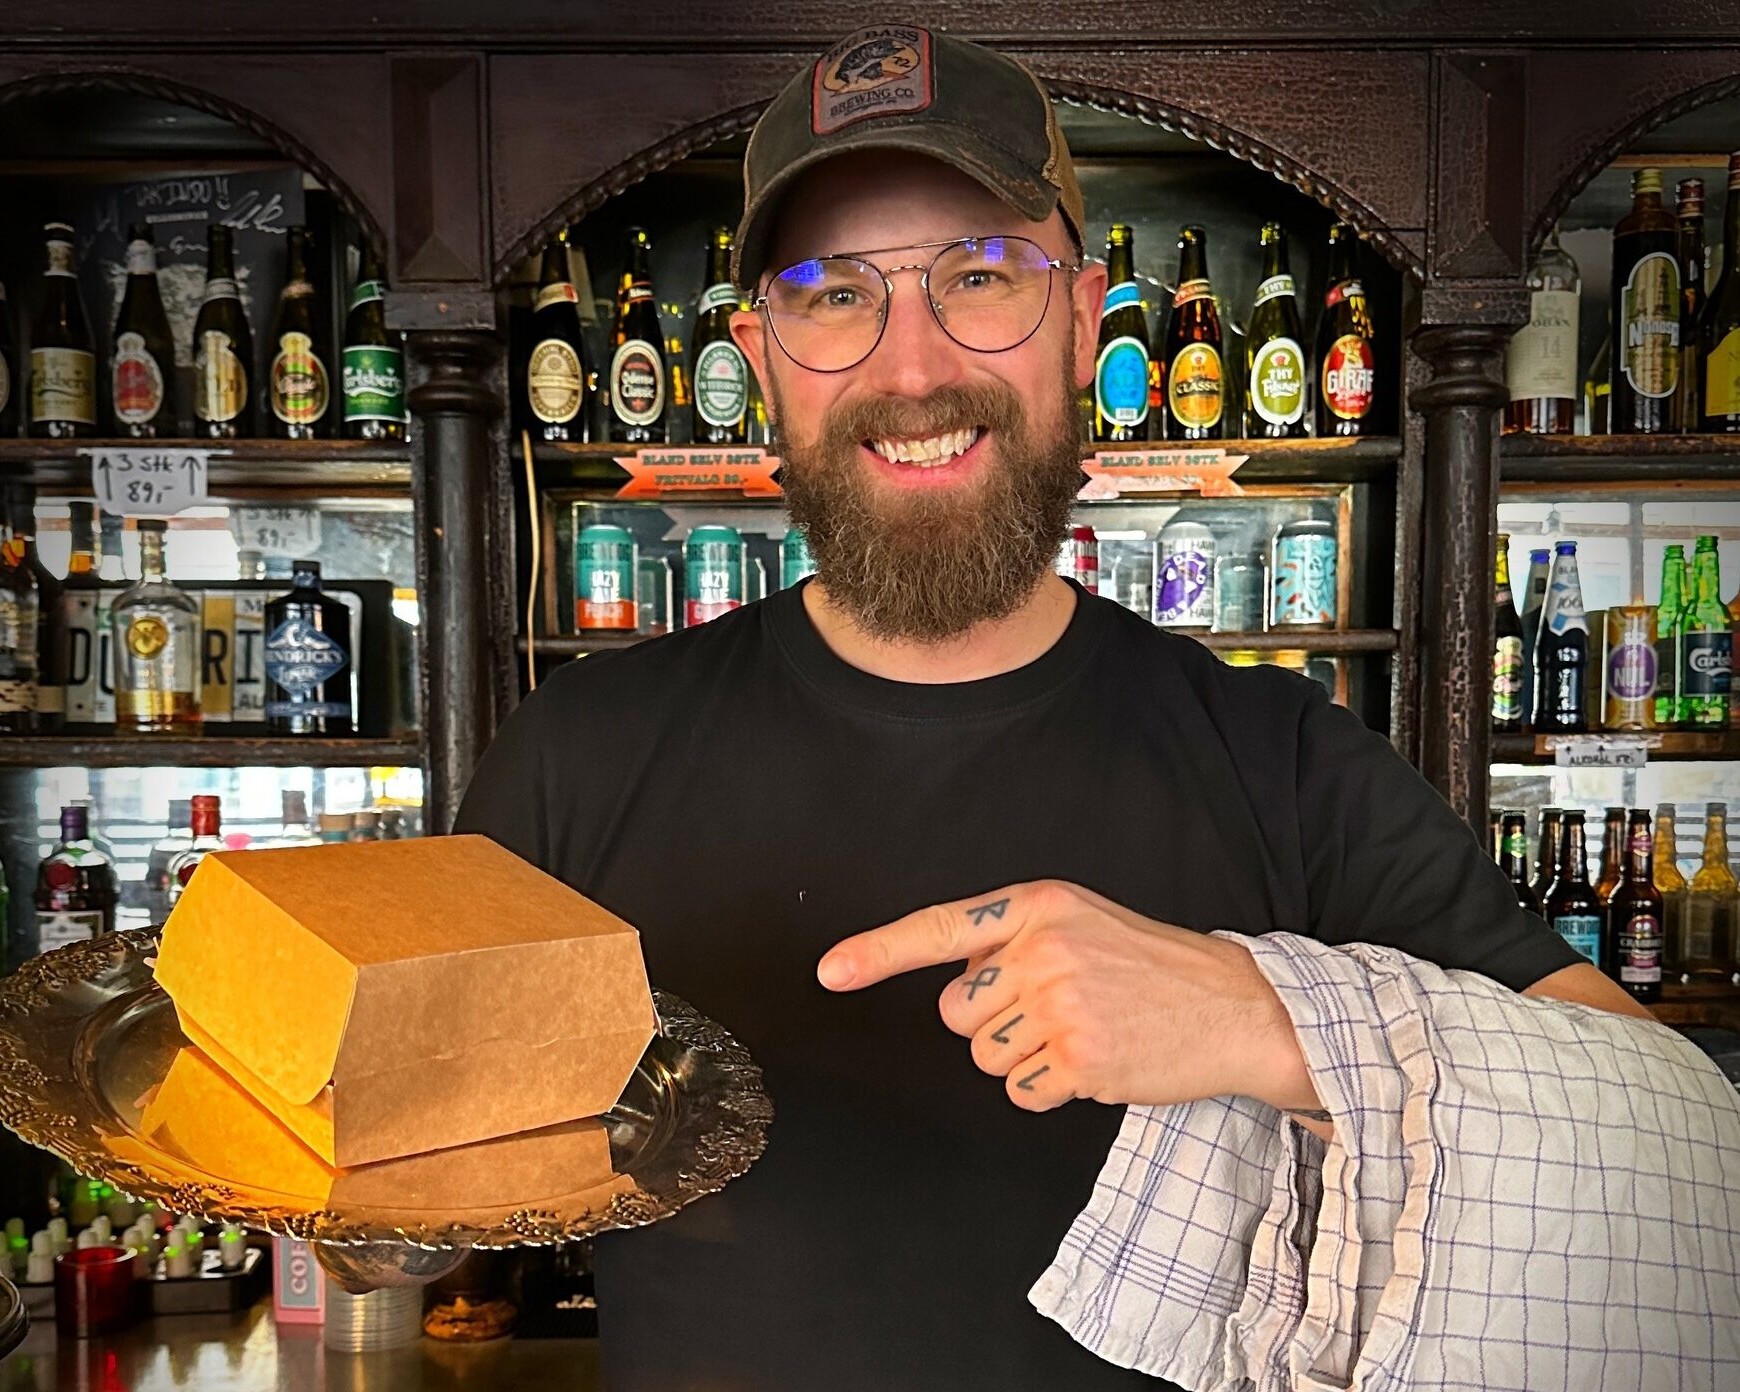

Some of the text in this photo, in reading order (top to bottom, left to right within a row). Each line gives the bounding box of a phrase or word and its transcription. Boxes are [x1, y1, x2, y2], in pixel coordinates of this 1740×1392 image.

[830, 87, 891, 117] BREWING
[1326, 368, 1375, 395] GIRAF
[116, 454, 133, 472] 3
